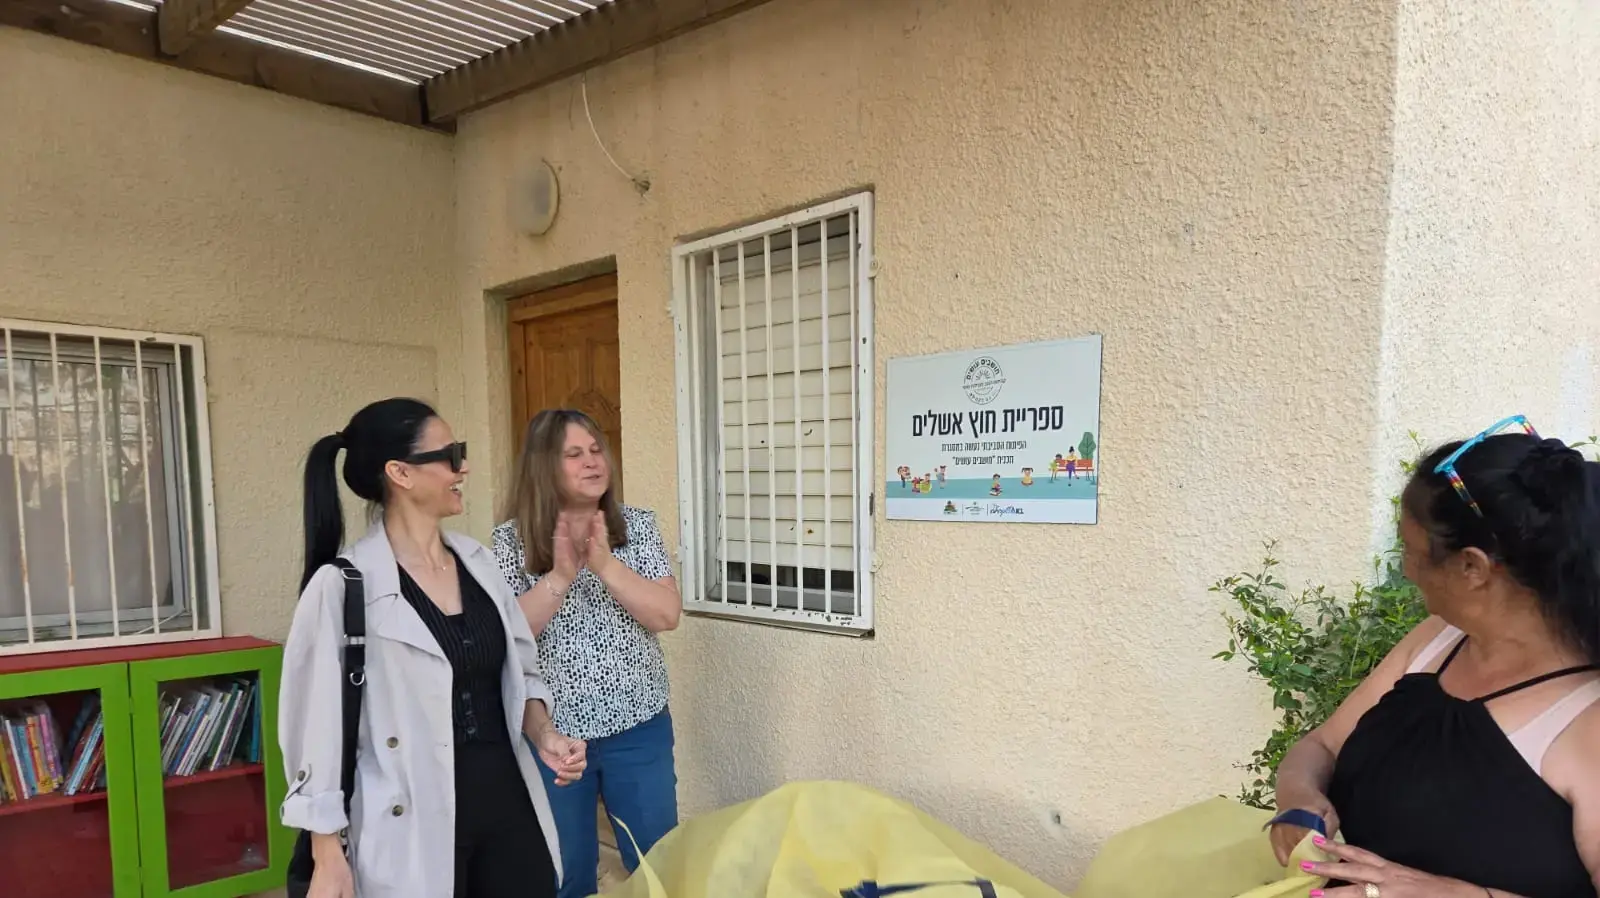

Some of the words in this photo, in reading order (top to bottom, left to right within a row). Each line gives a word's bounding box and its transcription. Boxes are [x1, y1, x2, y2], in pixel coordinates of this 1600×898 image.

[913, 409, 963, 436] אשלים
[969, 410, 996, 438] חוץ
[1002, 406, 1063, 433] ספריית
[942, 443, 963, 452] במסגרת
[964, 442, 980, 450] נעשה
[981, 442, 1004, 450] הסביבתי
[997, 456, 1013, 464] תכנית
